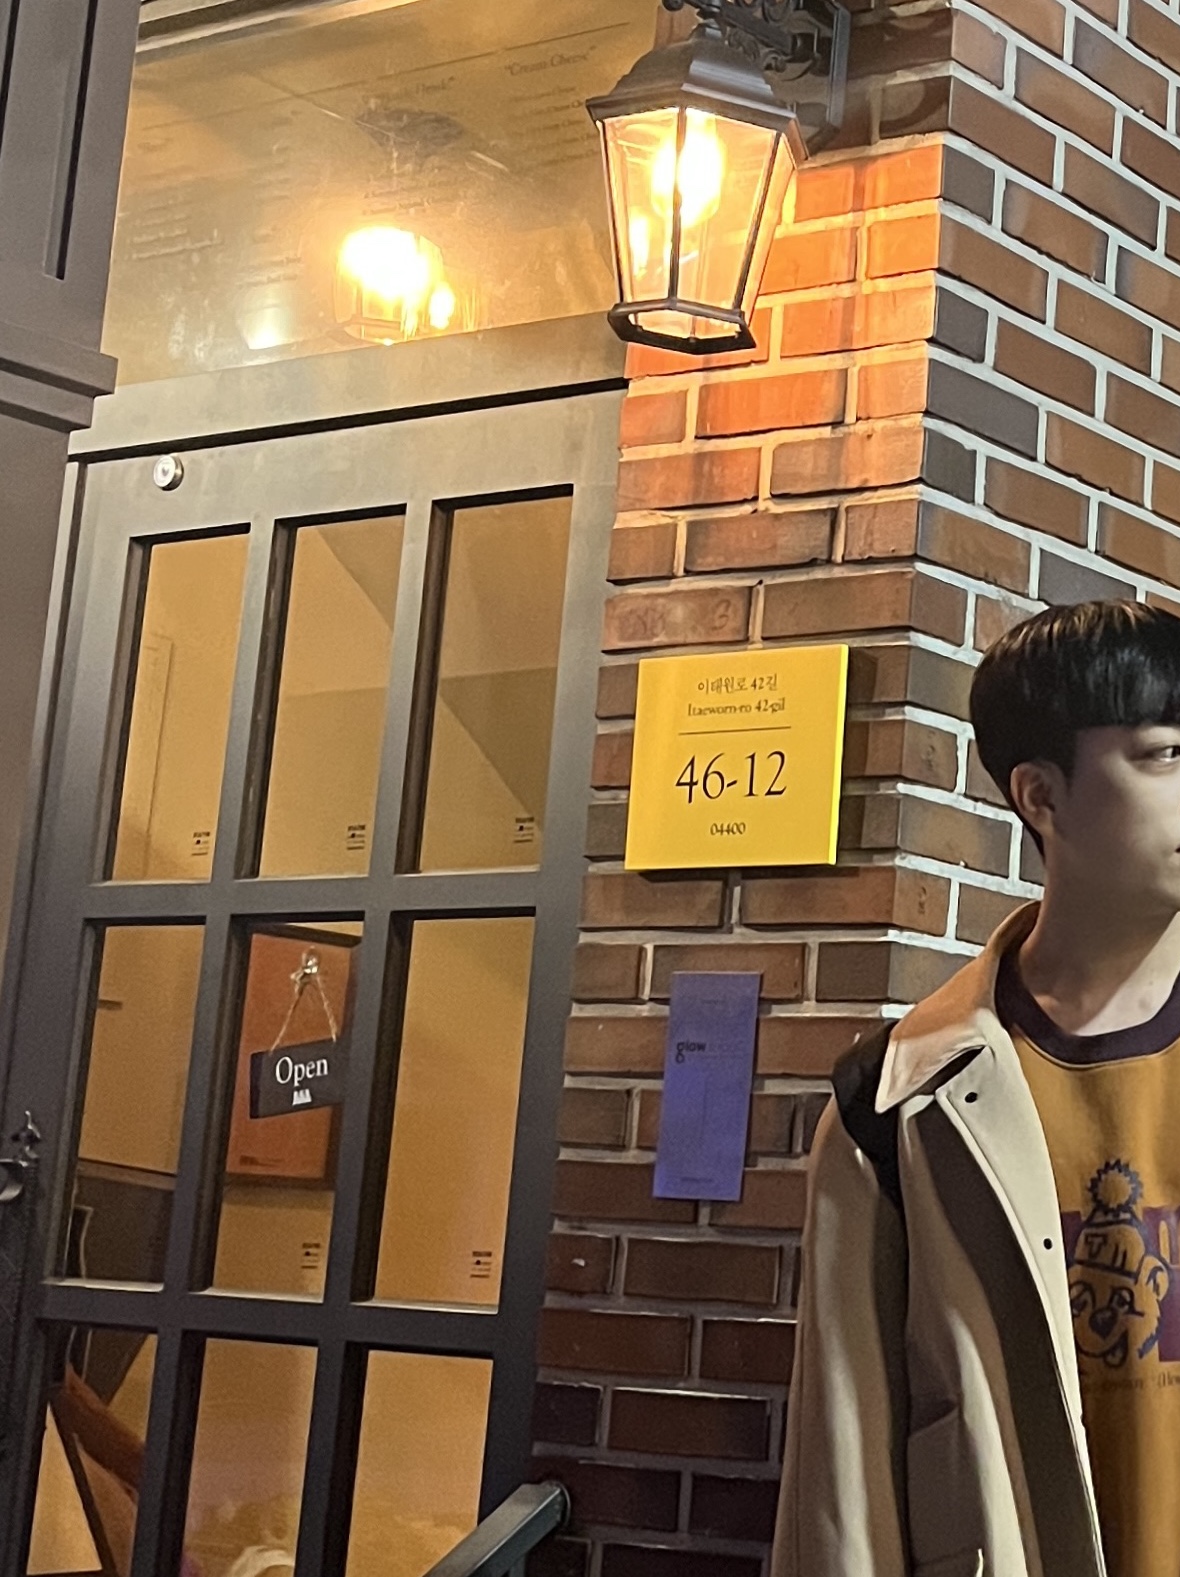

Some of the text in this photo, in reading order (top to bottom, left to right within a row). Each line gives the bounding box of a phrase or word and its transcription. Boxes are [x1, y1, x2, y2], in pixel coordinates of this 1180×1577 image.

[697, 673, 777, 695] 이태원로 42길
[687, 697, 785, 717] Itaewon-ro 42-gil
[675, 750, 788, 804] 46-12
[709, 822, 746, 836] 04400
[675, 1039, 708, 1065] glow
[275, 1055, 329, 1087] Open
